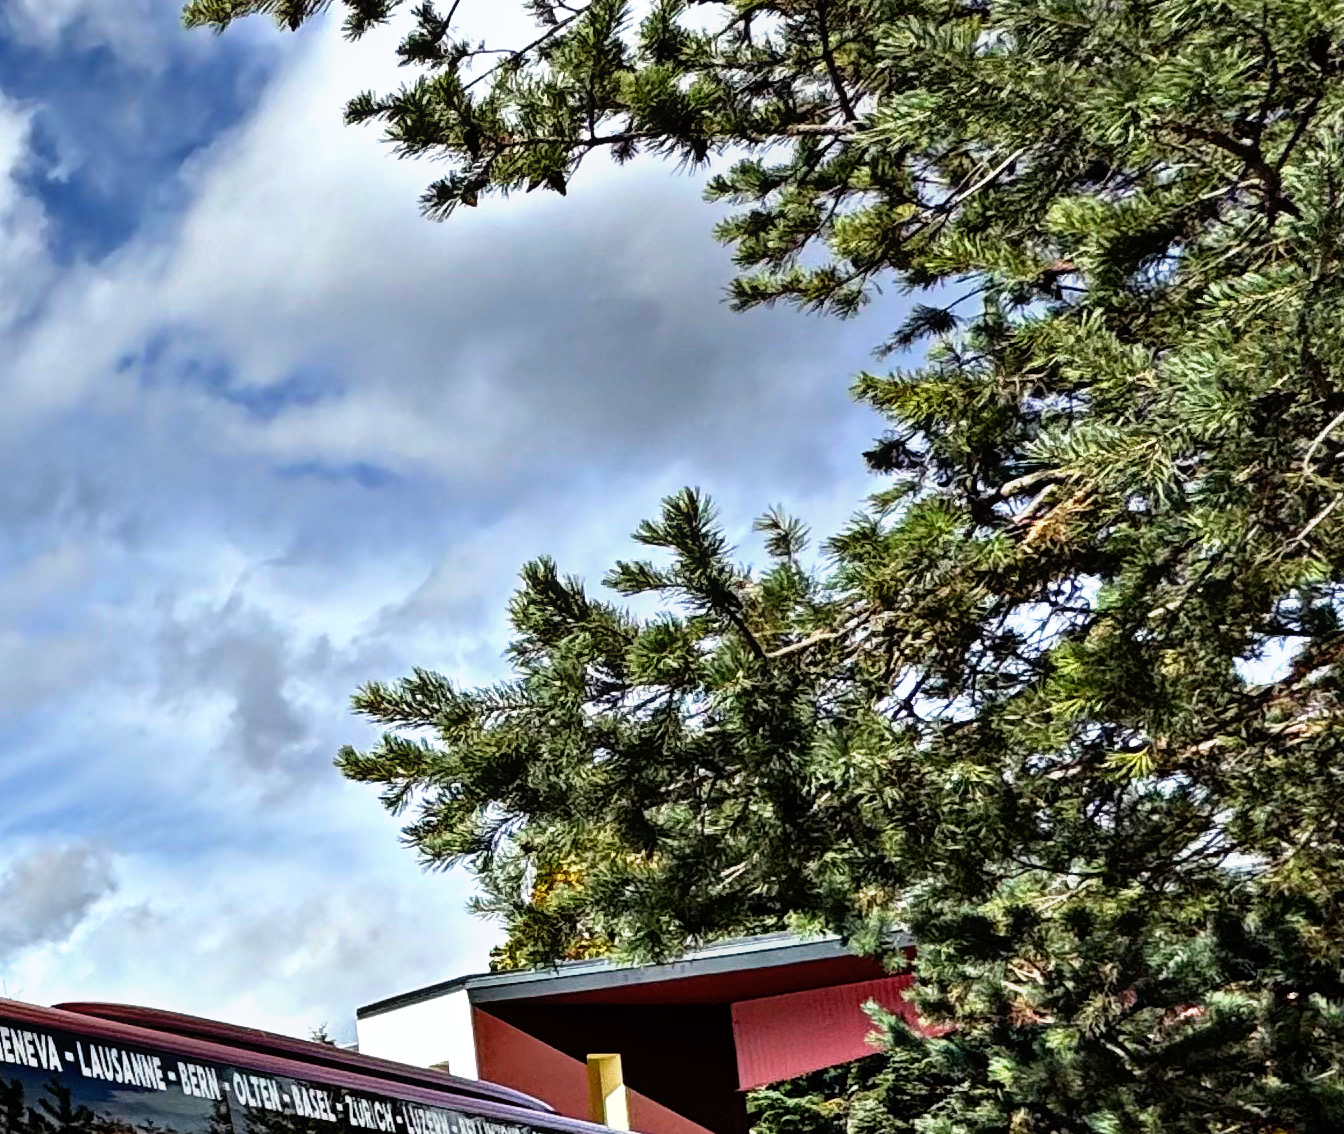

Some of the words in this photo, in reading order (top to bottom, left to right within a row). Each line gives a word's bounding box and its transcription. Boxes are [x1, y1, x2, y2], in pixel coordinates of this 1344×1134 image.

[75, 1041, 167, 1091] LAUSANNE
[177, 1061, 223, 1100] BERN
[232, 1072, 283, 1112] OLTEN
[290, 1084, 337, 1122] BASEL
